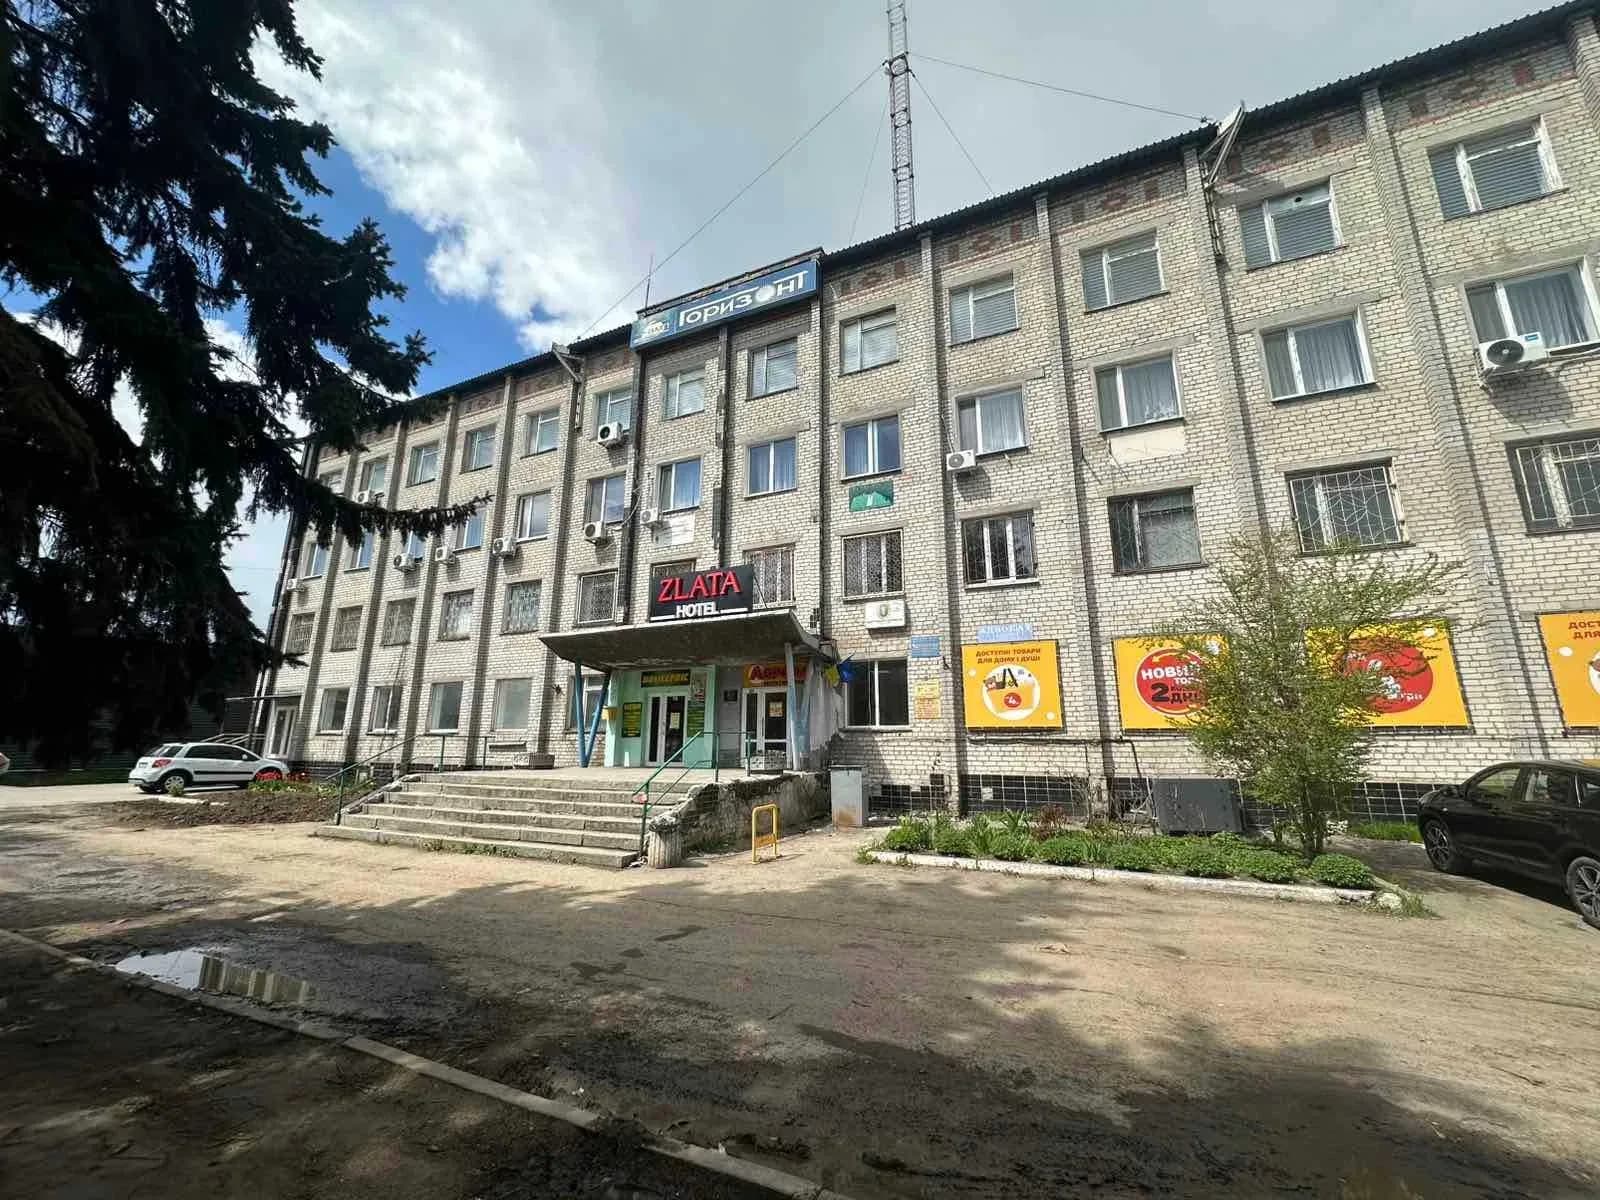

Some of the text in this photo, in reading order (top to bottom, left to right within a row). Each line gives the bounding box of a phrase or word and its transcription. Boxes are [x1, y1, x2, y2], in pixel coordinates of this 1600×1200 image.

[658, 570, 742, 603] ZLATA
[676, 601, 719, 618] HOTEL
[994, 656, 1015, 664] ДОМУ
[1151, 682, 1169, 703] 2
